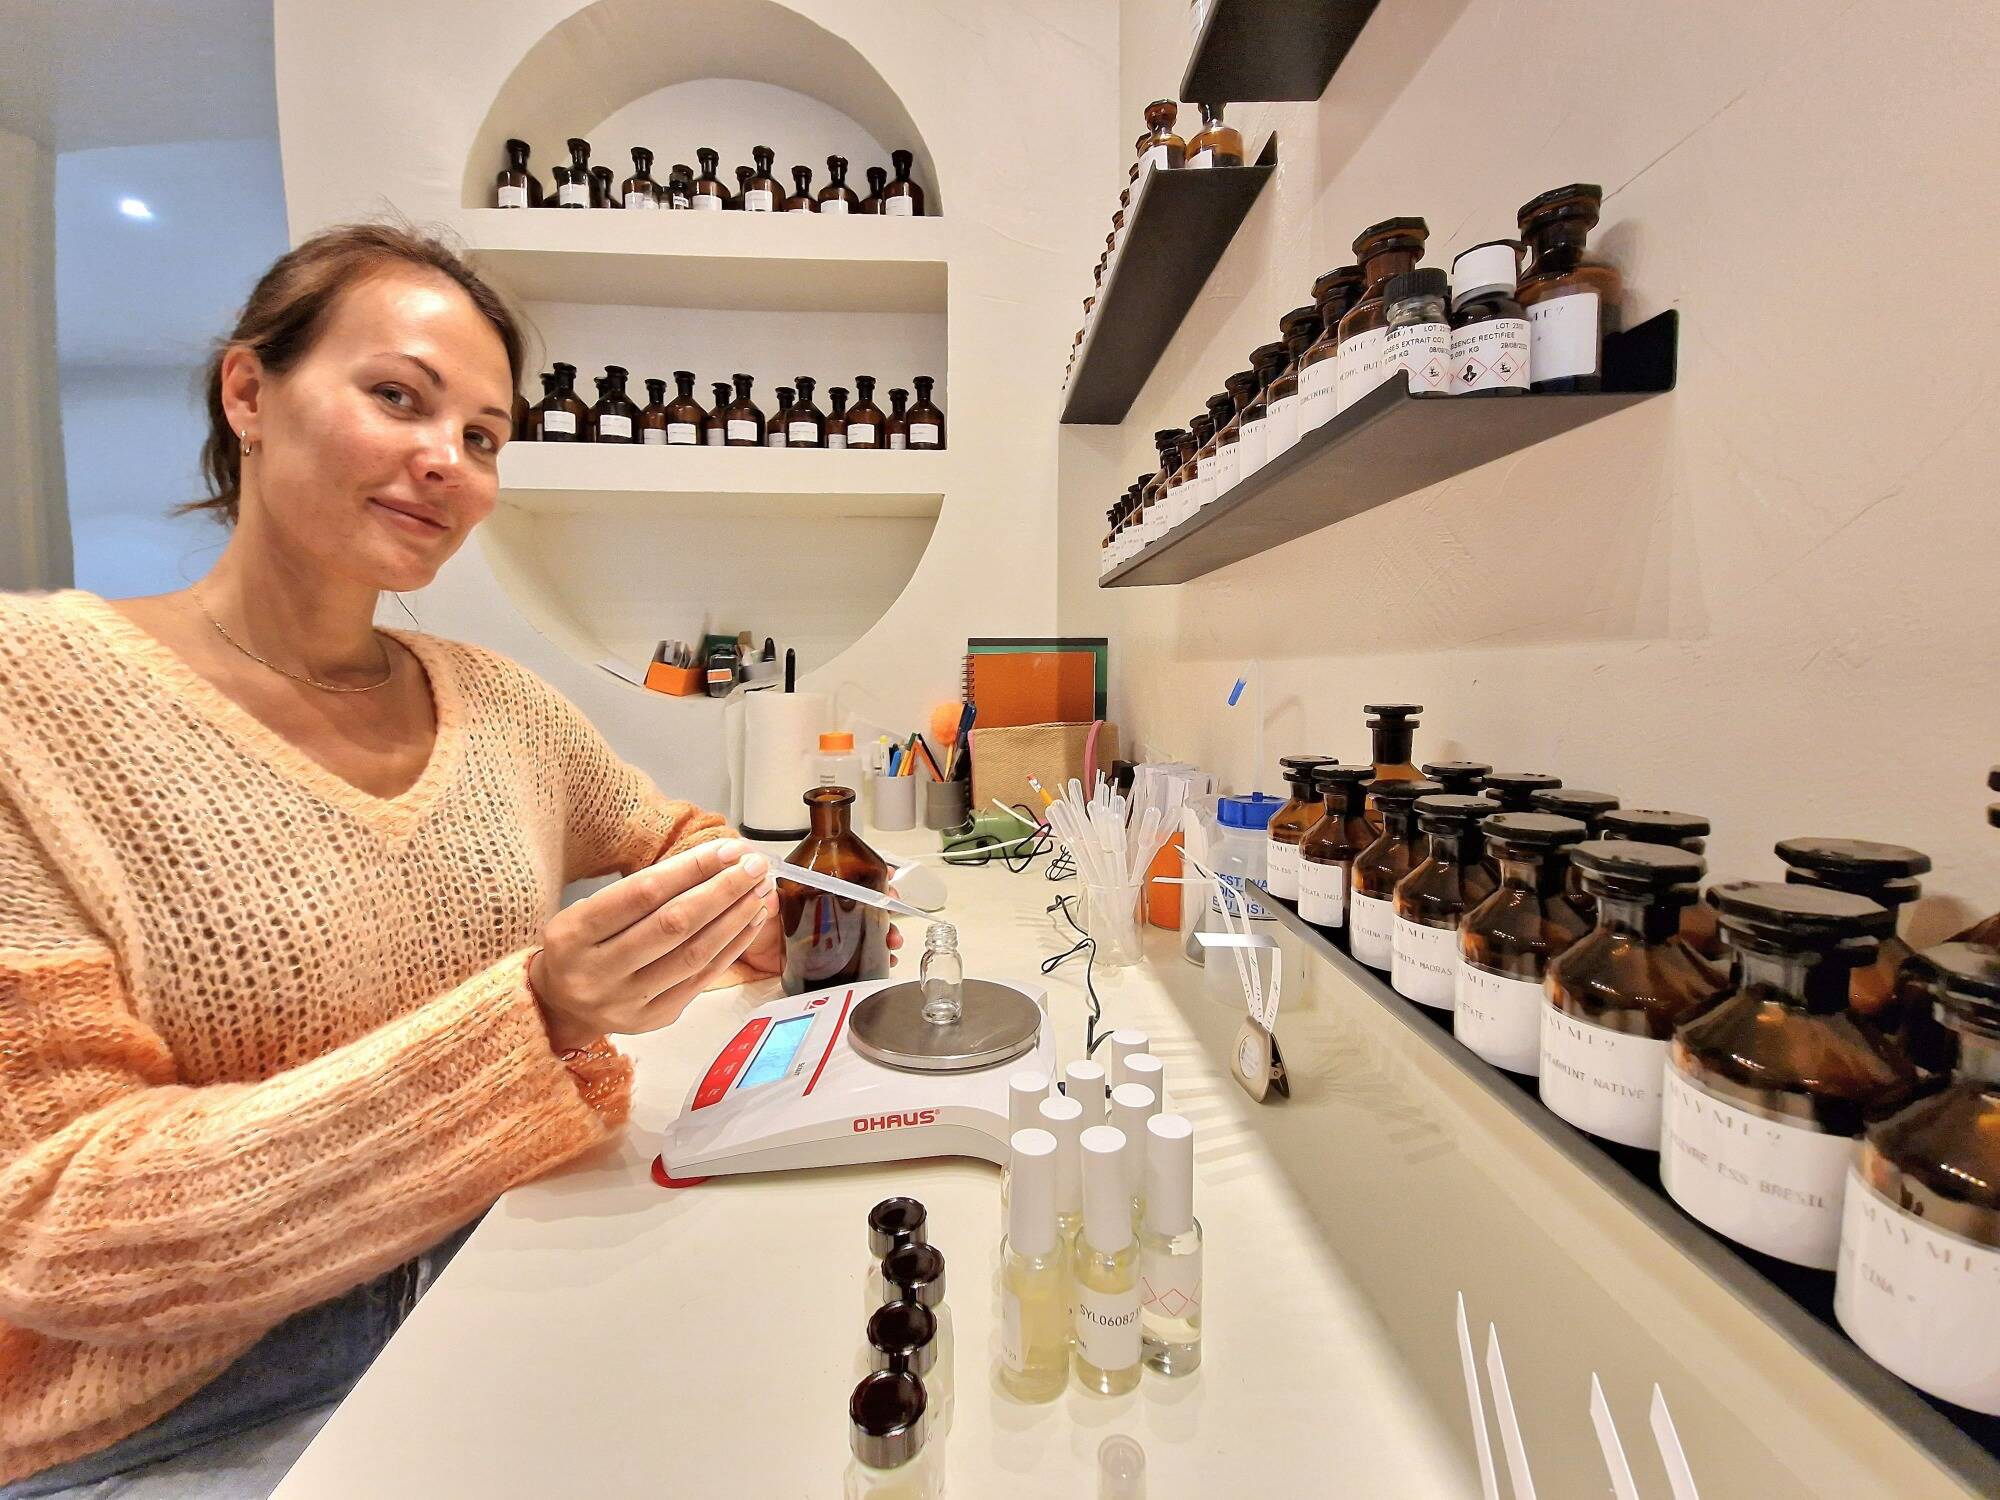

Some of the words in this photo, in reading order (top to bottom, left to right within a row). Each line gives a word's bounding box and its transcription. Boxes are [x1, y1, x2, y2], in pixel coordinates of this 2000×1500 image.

[1402, 337, 1430, 348] EXTRAIT
[1468, 346, 1480, 354] KG
[1212, 895, 1233, 911] EU
[1419, 961, 1453, 976] MADRAS
[1592, 1077, 1645, 1099] NATIVE
[853, 1110, 936, 1133] OHAUS
